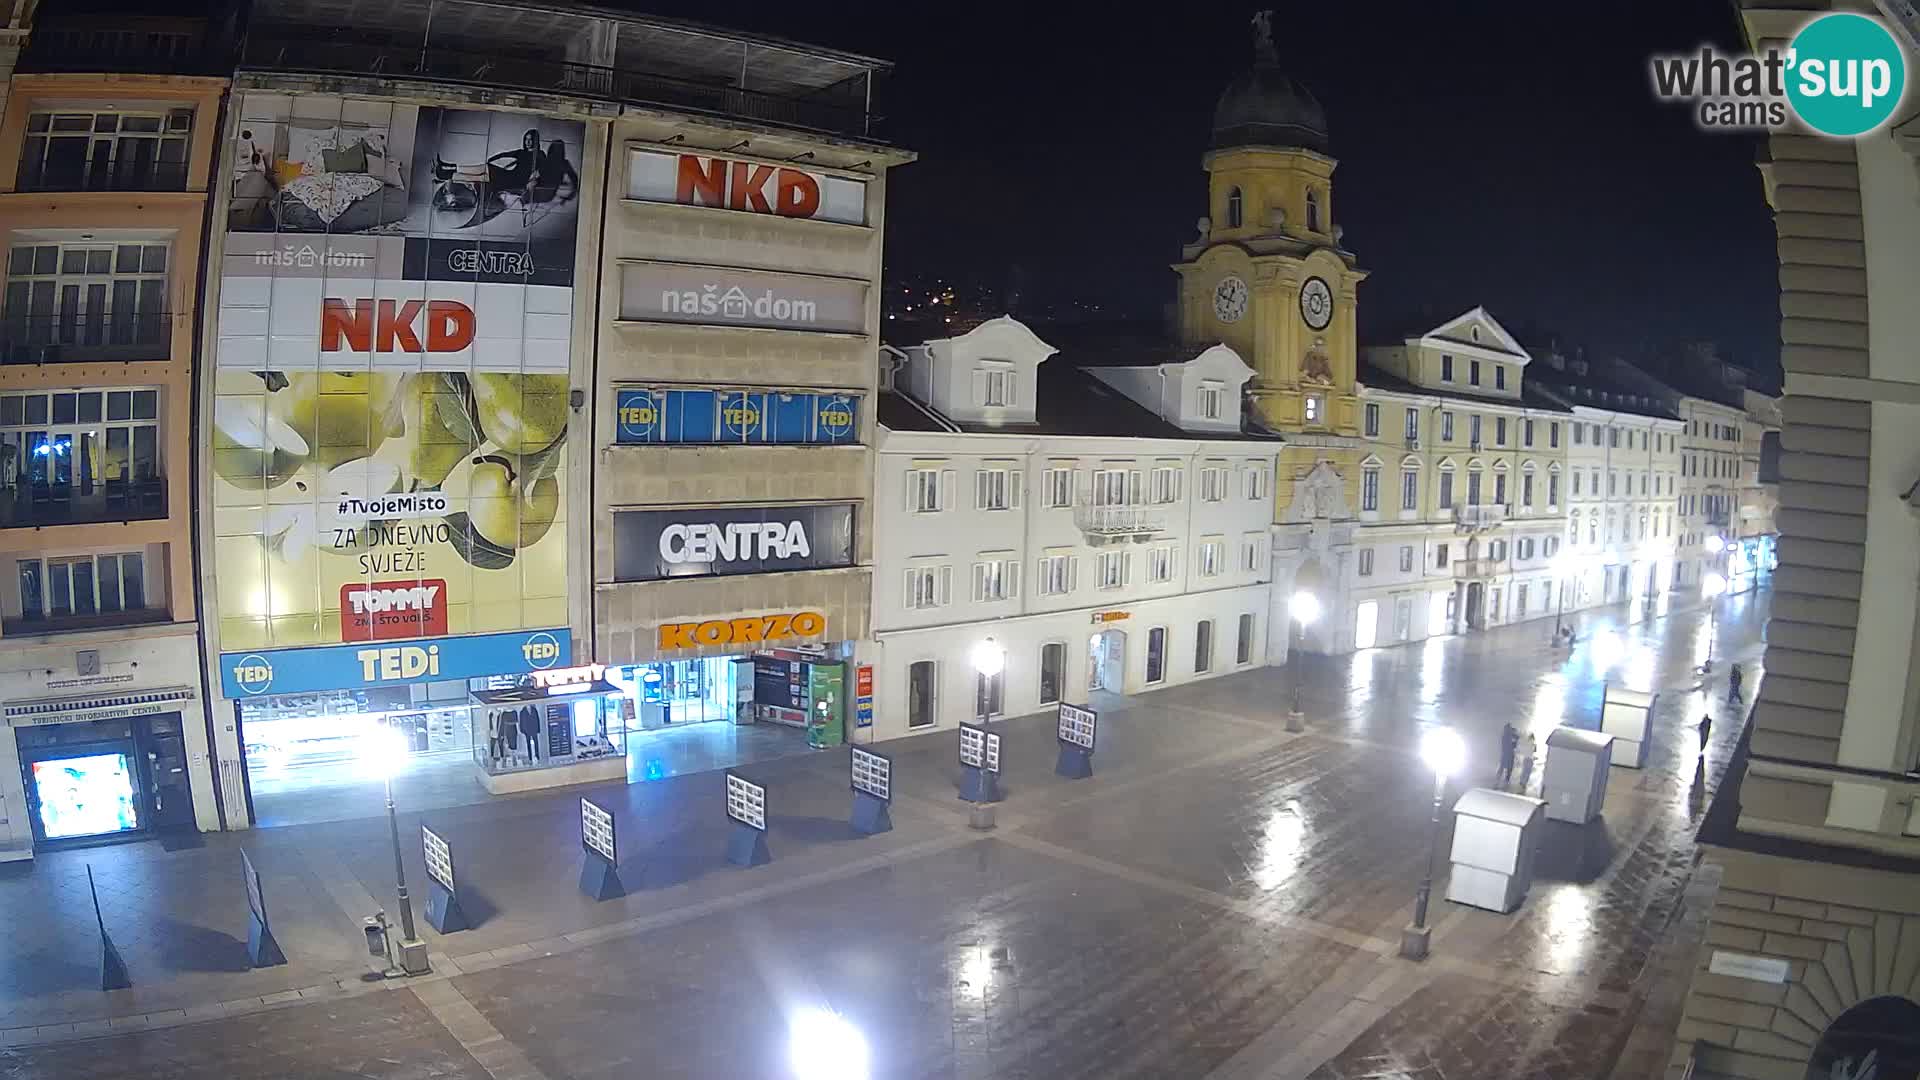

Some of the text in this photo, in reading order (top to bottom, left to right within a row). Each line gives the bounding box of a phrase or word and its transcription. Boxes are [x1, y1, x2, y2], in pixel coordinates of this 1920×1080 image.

[676, 154, 822, 219] NKD
[448, 249, 535, 276] CENTRA
[661, 284, 817, 323] naš dom
[320, 297, 478, 353] NKD
[618, 406, 657, 426] TEDi
[338, 496, 446, 516] #TvojeMisto
[333, 523, 450, 548] ZA DNEVNO
[659, 520, 811, 564] CENTRA
[359, 548, 426, 575] SVJEŽE
[348, 586, 440, 614] TOMMY
[659, 611, 827, 649] KORZO
[358, 644, 440, 682] TEDi
[522, 643, 560, 660] TEDi
[233, 665, 273, 684] TEDi
